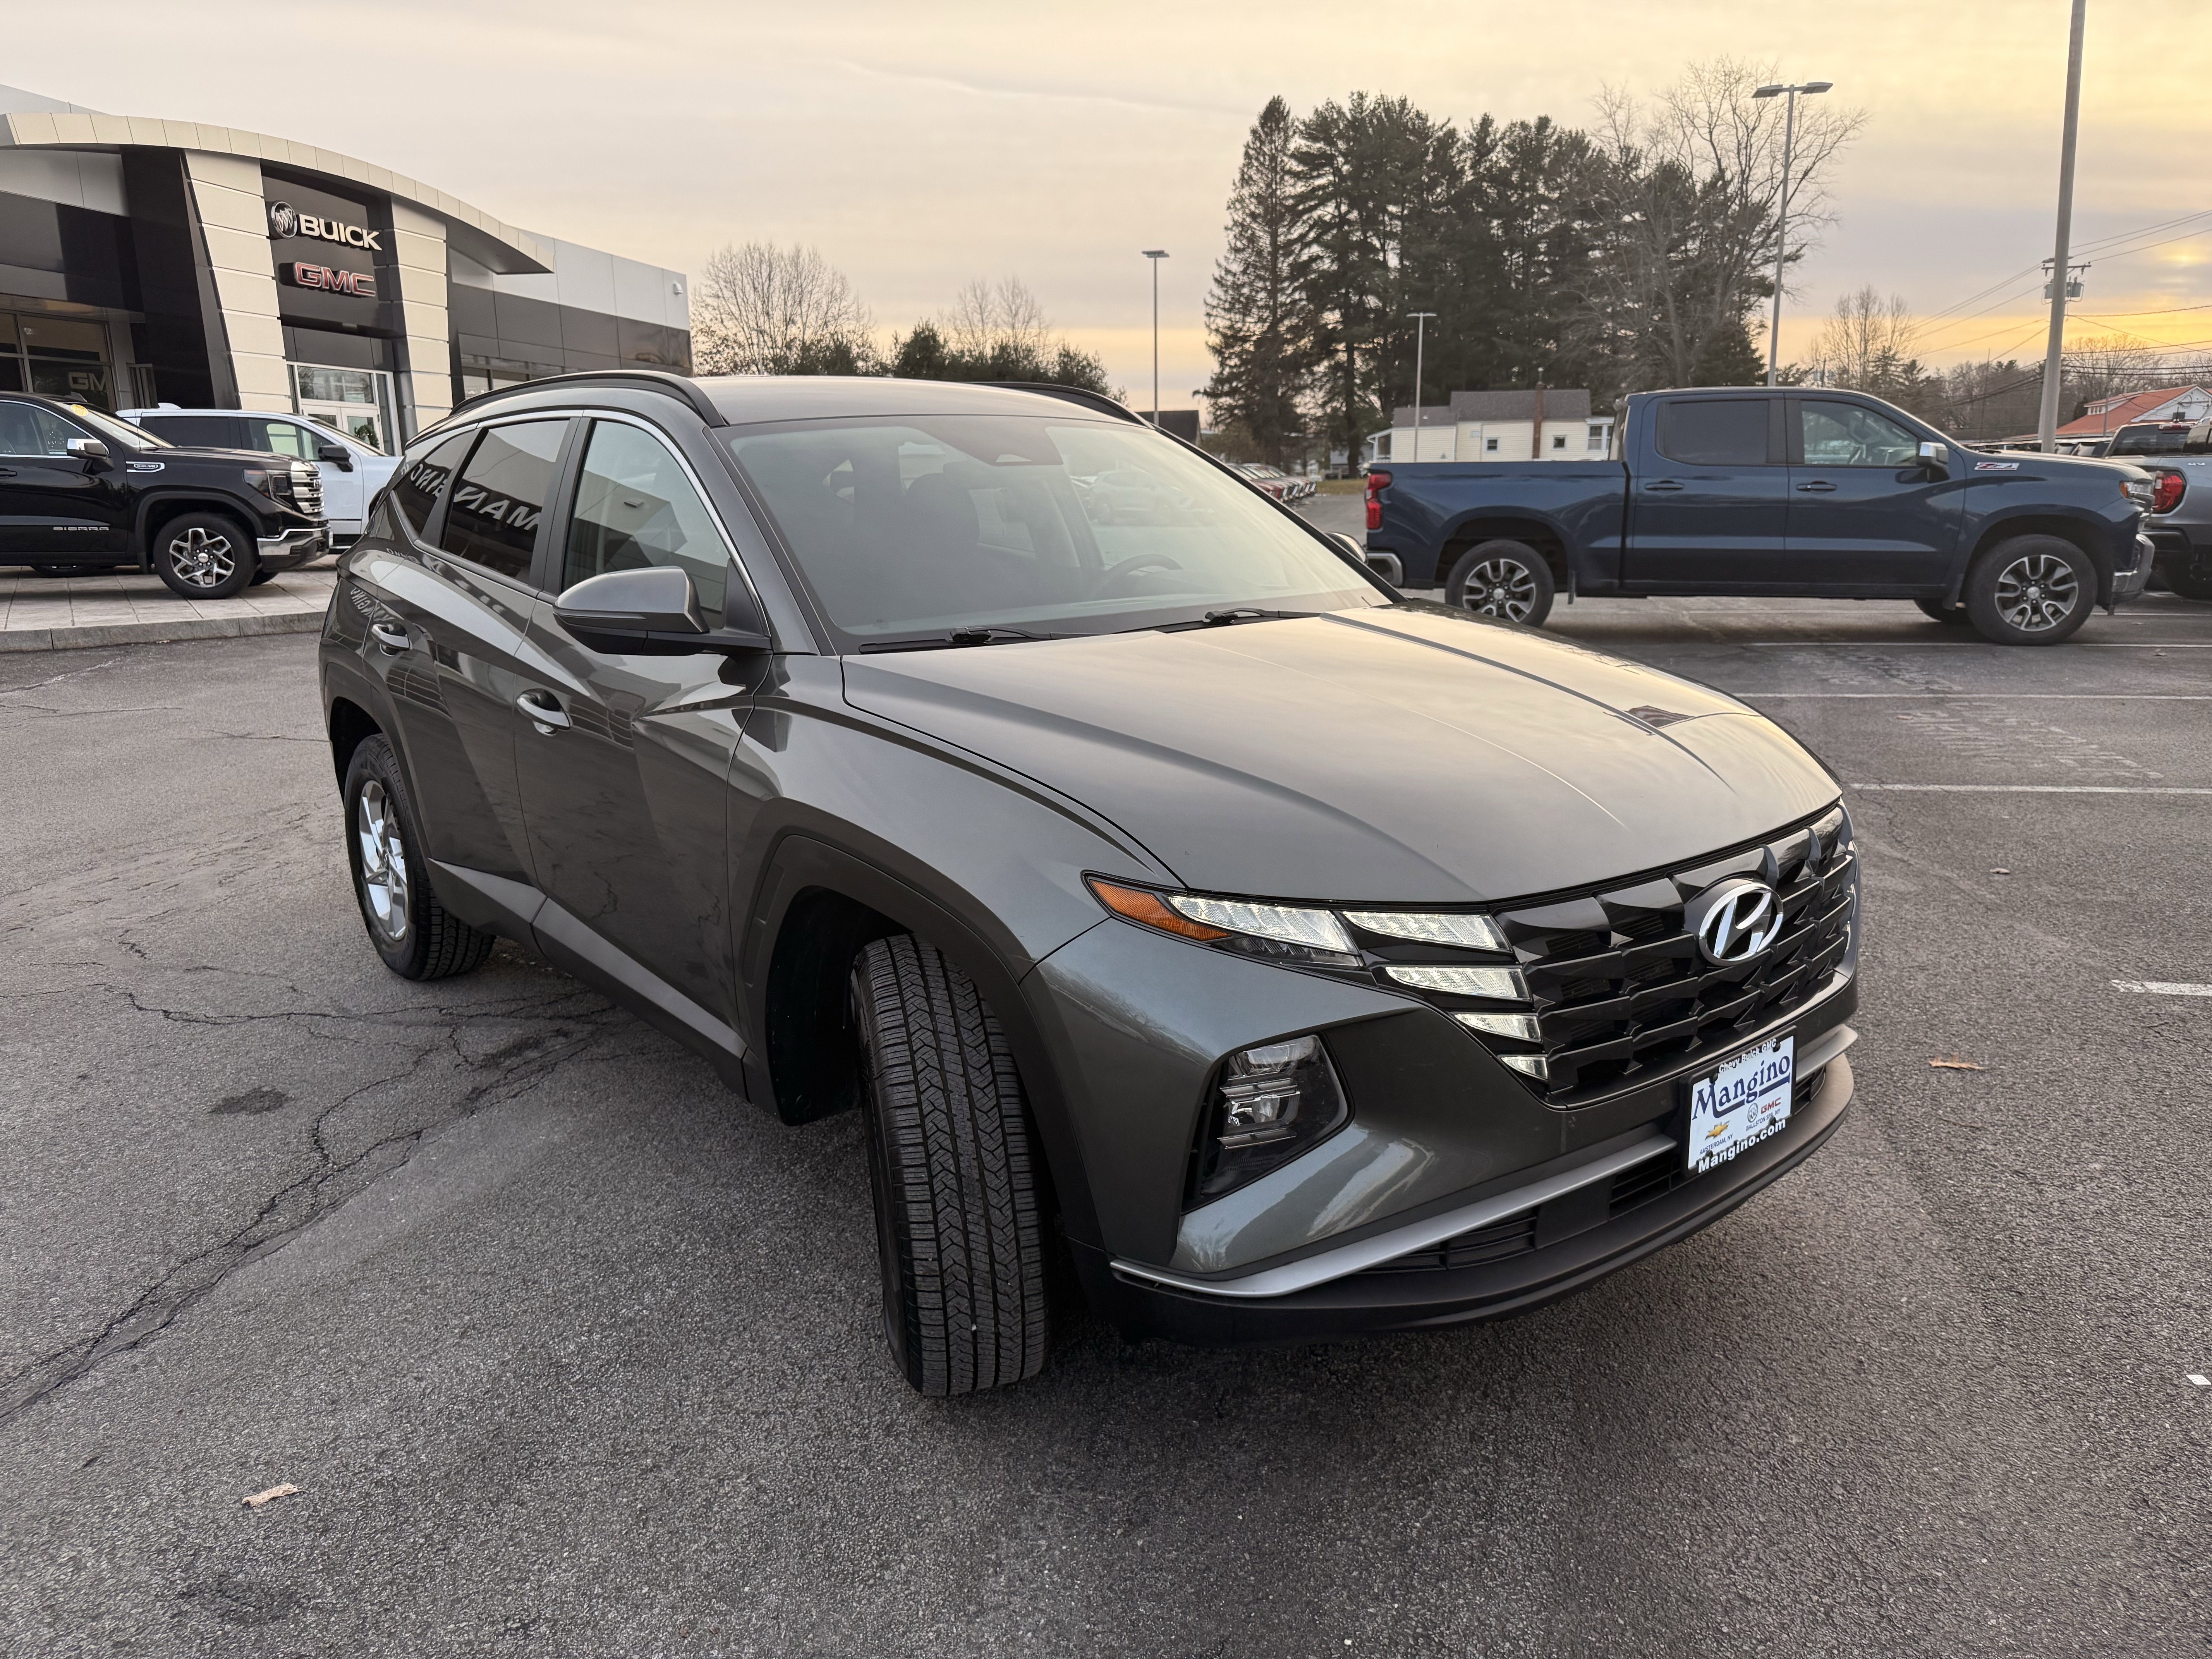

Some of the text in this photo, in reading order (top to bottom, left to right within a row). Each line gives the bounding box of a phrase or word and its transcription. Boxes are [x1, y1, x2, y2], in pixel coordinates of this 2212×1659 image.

[299, 214, 382, 251] BUICK
[295, 262, 376, 297] GMC
[1719, 1038, 1776, 1073] Chevy Buick GMC
[1692, 1056, 1790, 1120] Mangino
[1761, 1097, 1781, 1114] GMC
[1746, 1116, 1765, 1131] BALLSTON
[1698, 1119, 1786, 1173] Mangino.com
